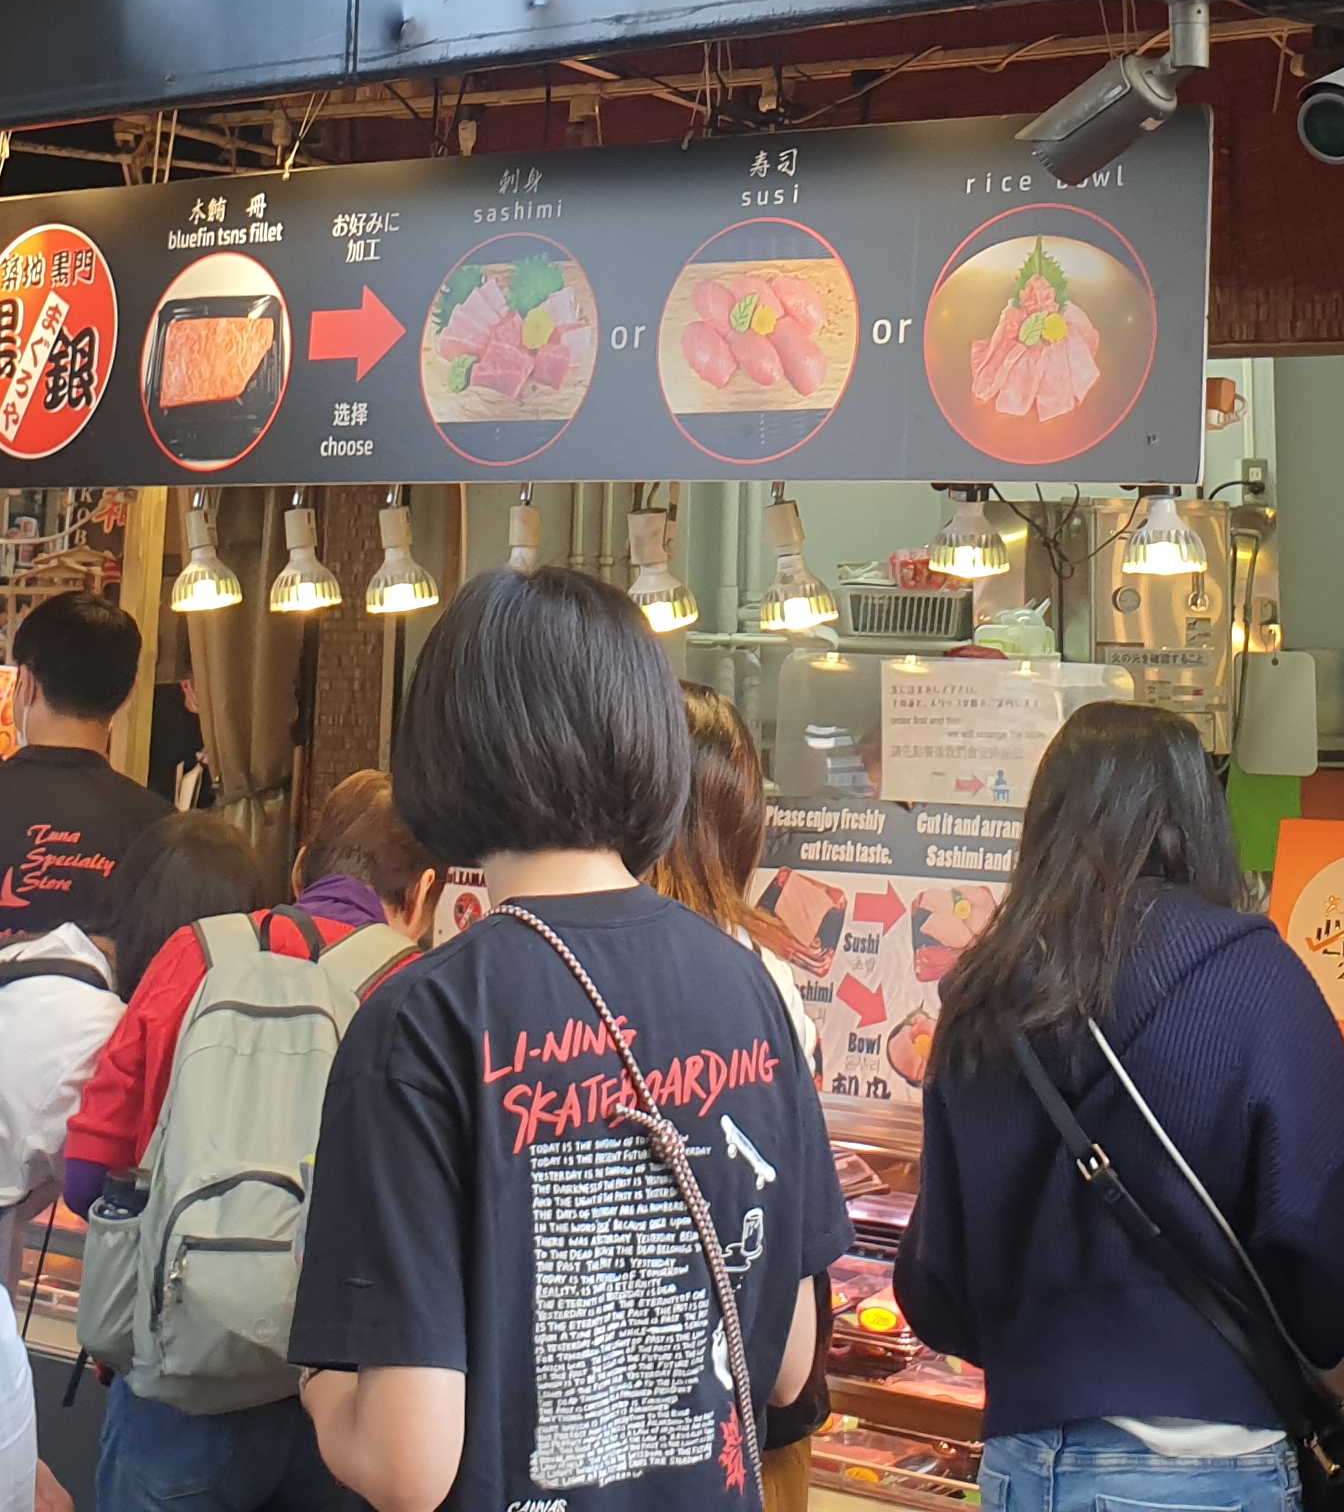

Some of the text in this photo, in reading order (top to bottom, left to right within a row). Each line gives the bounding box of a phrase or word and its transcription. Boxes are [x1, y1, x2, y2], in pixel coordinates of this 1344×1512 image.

[748, 147, 800, 179] 寿司
[499, 168, 543, 194] 刺身
[965, 170, 1032, 195] rice
[740, 183, 801, 209] susi
[473, 198, 564, 225] sashimi
[169, 227, 216, 250] bluefin
[248, 221, 283, 245] fillet
[332, 212, 400, 238] お好みに
[346, 238, 380, 264] 加工
[51, 248, 96, 288] 黒門
[609, 319, 647, 350] or
[870, 314, 913, 346] or
[319, 435, 373, 459] choose
[765, 806, 886, 835] Please enjoy freshly
[917, 812, 941, 834] Cut
[942, 813, 954, 835] it
[954, 815, 980, 836] and
[26, 824, 82, 845] Tuna
[20, 847, 116, 878] Specialty
[801, 841, 892, 864] cut fresh taste.
[926, 845, 984, 869] Sashimi
[985, 848, 1012, 871] and
[16, 871, 73, 893] Store
[843, 933, 880, 955] Sushi
[848, 1032, 881, 1055] Bowl
